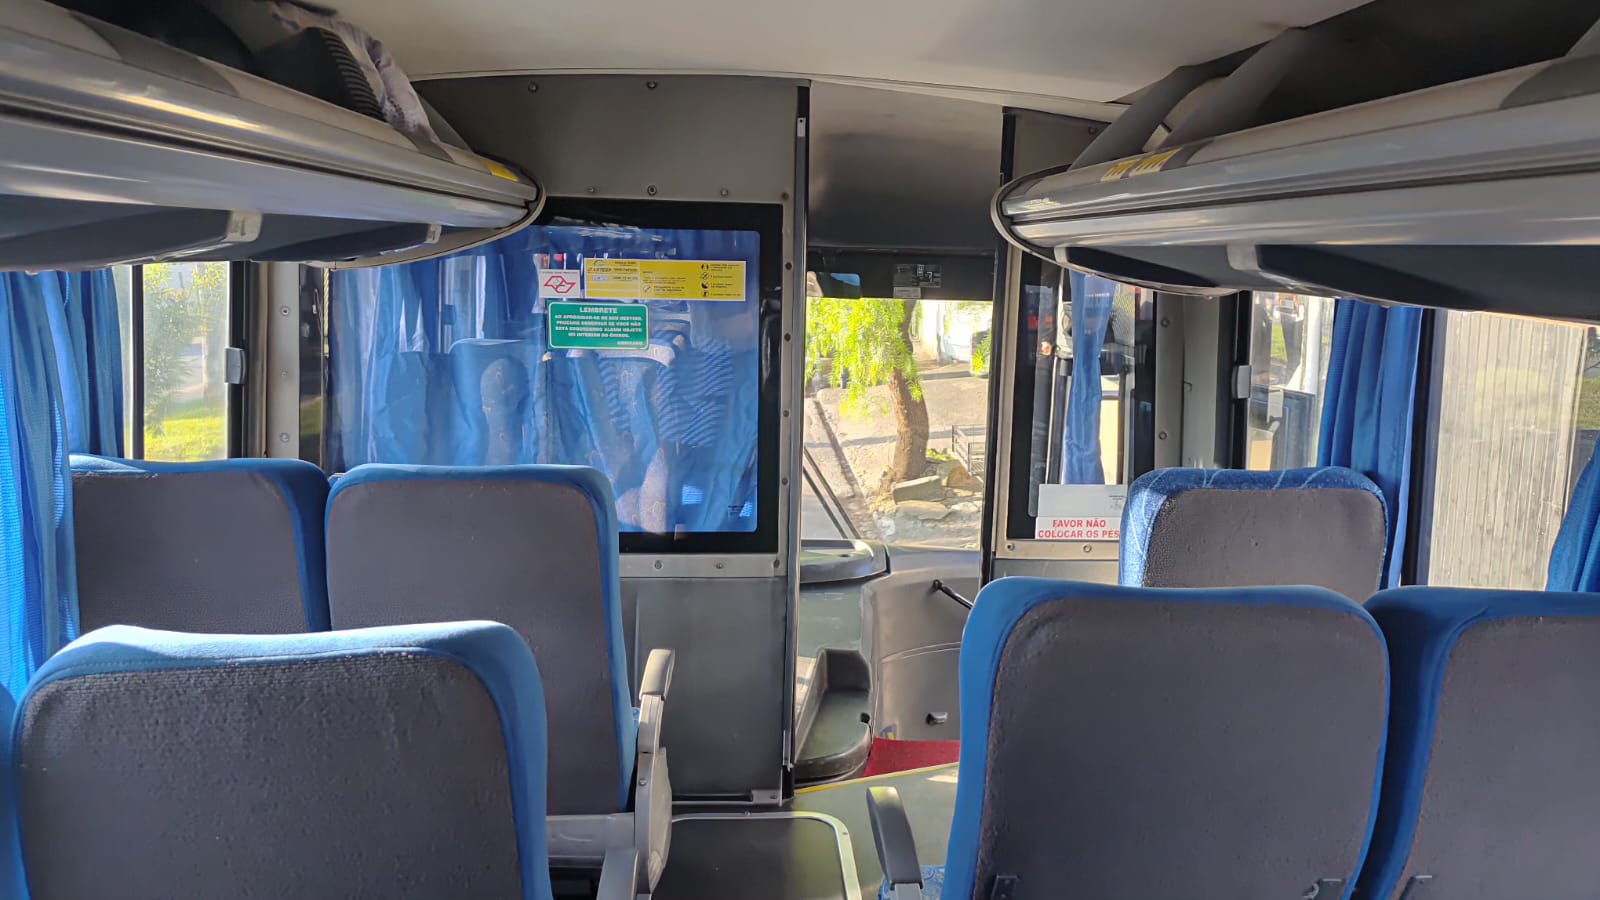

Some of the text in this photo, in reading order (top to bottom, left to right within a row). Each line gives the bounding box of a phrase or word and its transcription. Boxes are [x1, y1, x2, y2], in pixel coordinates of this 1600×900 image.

[1053, 518, 1106, 528] FAVOR NÃO
[1038, 528, 1120, 538] COLOCAR OS PÉS
